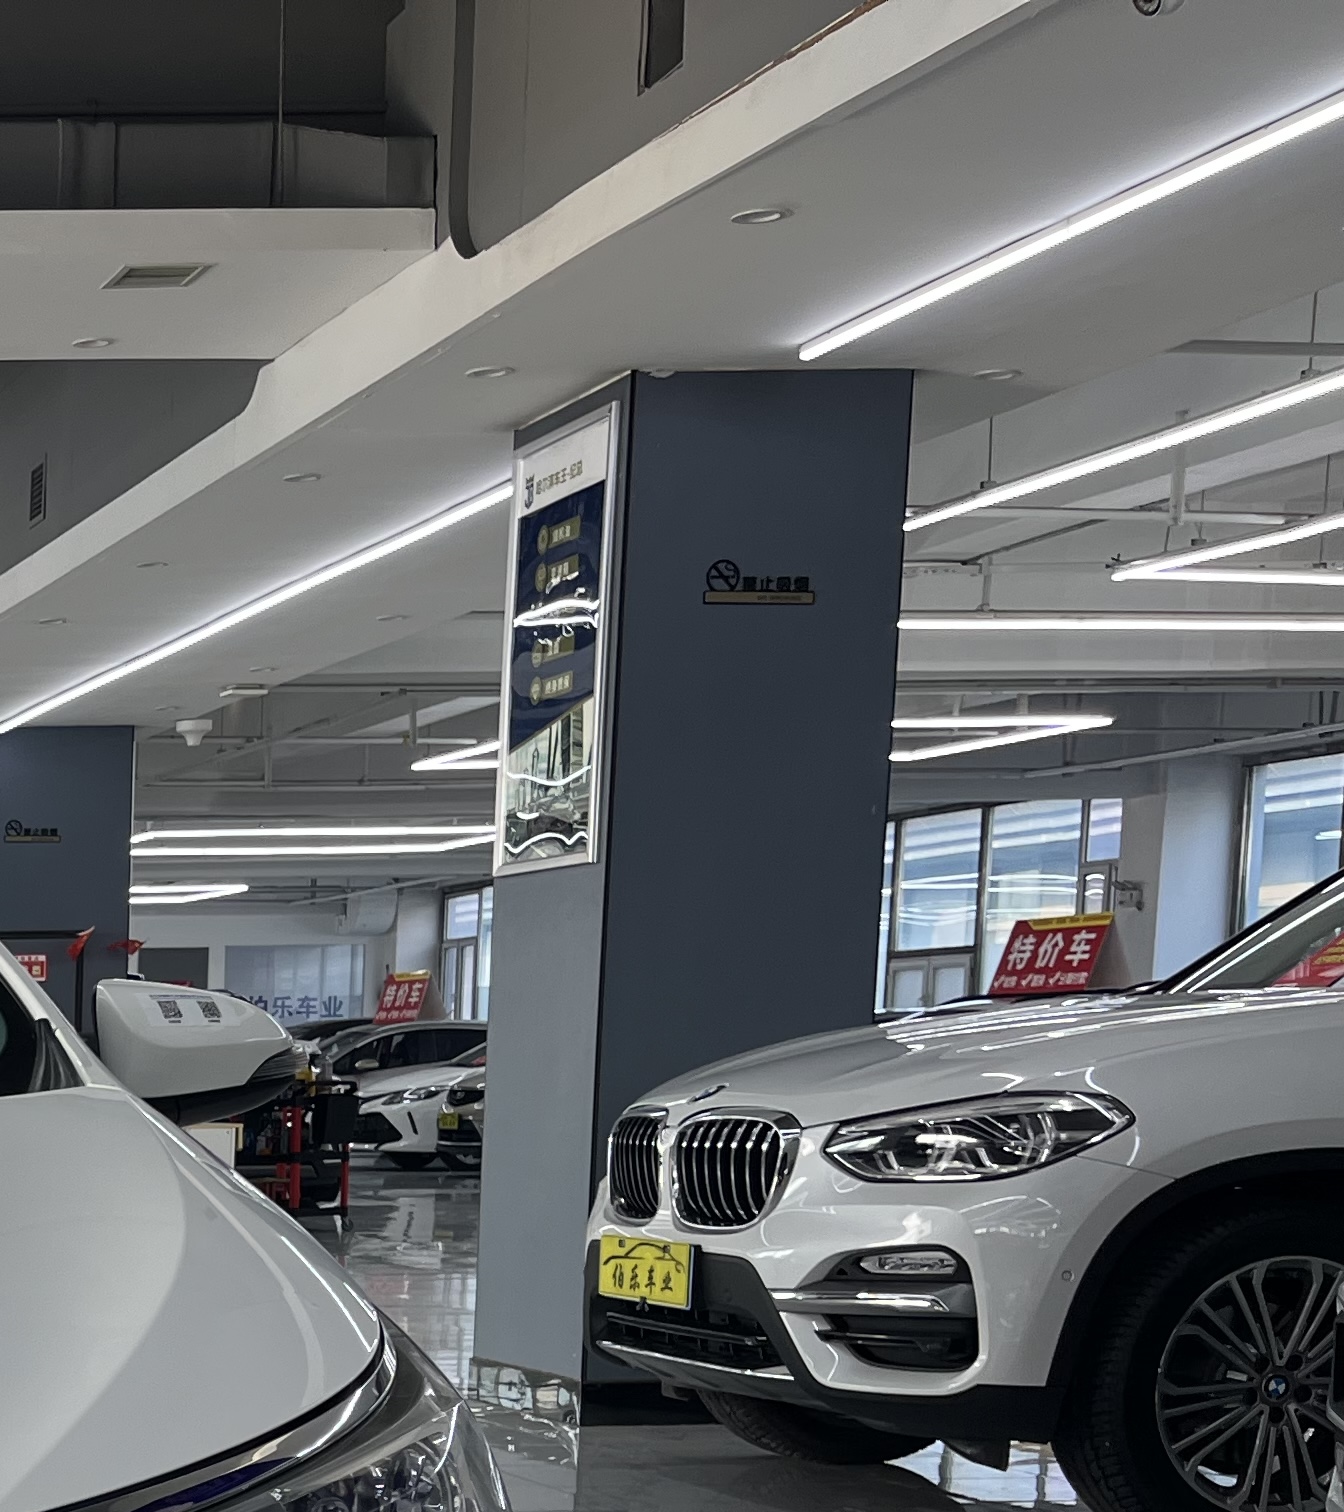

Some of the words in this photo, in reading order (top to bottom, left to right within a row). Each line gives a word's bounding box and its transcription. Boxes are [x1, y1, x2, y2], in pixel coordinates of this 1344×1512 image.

[1007, 930, 1097, 971] 特价车
[383, 982, 423, 1008] 特价车
[612, 1263, 673, 1295] 伯乐车业
